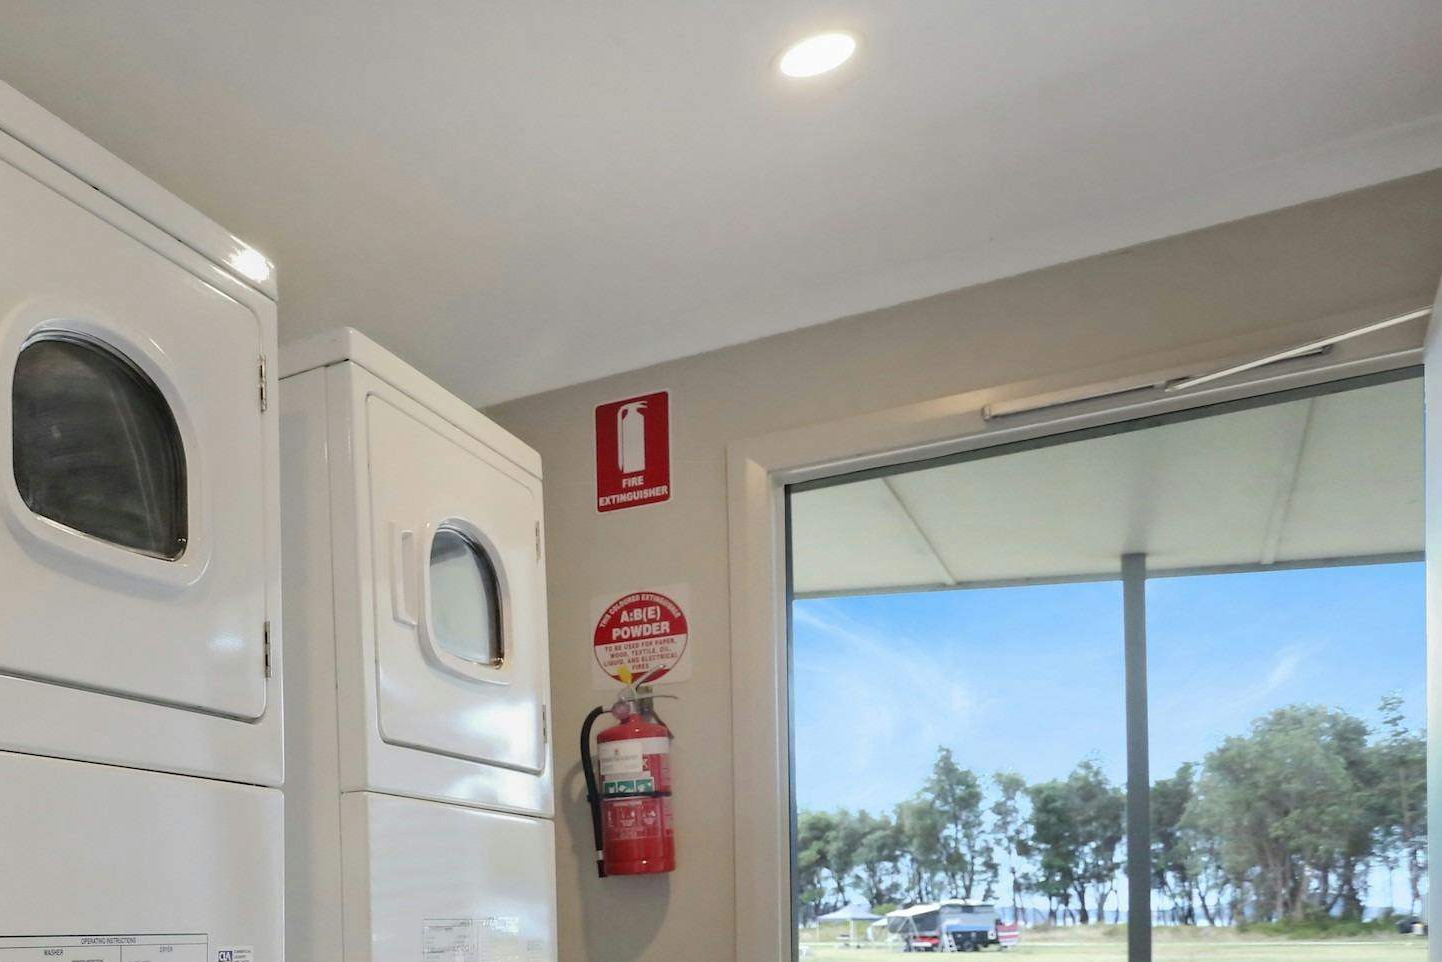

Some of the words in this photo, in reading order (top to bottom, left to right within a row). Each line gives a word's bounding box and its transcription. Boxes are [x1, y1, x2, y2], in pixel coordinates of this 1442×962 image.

[622, 476, 644, 488] FIRE
[599, 485, 669, 506] EXTINGUISHER
[620, 606, 661, 623] A:B(E)
[612, 621, 670, 640] POWDER
[641, 653, 678, 662] ELECTRICAL
[218, 952, 232, 961] CLA
